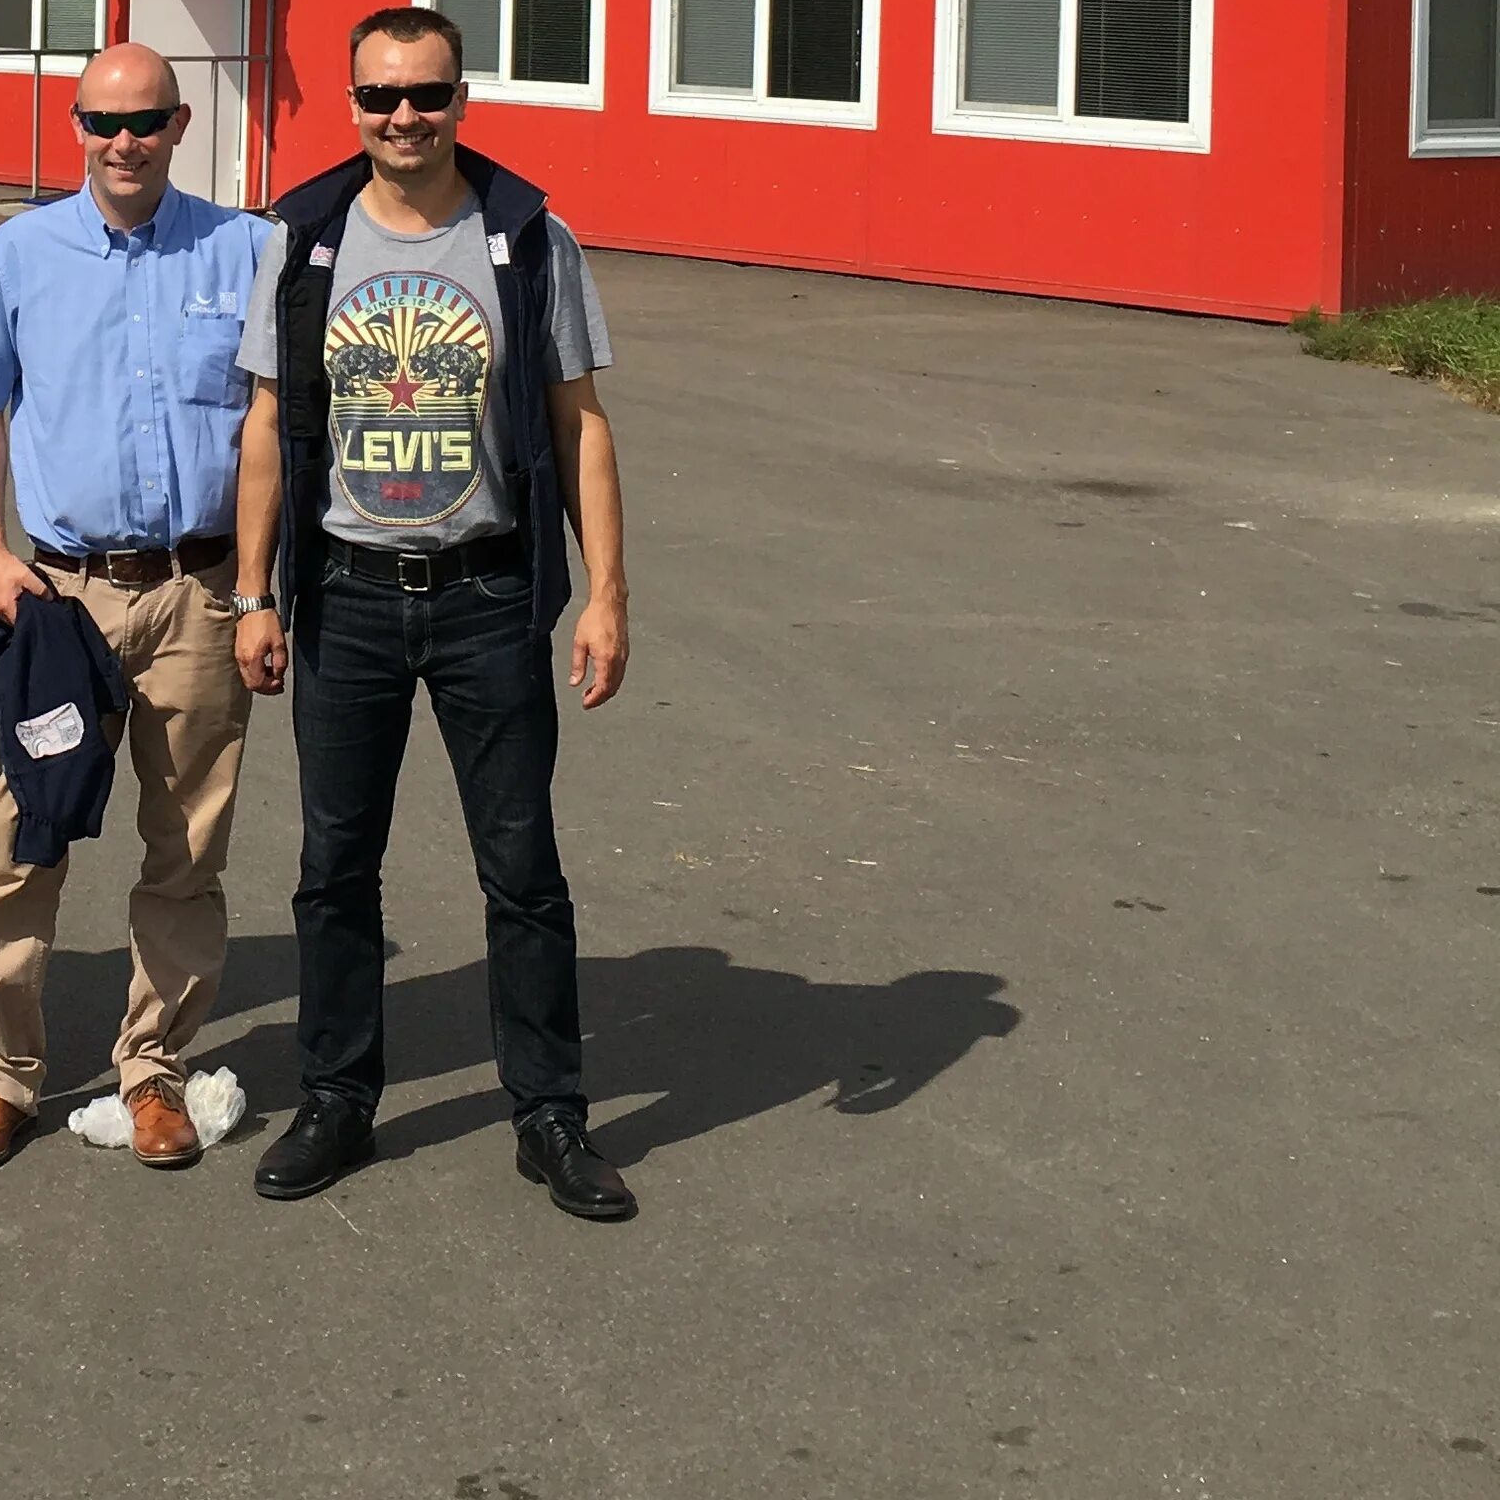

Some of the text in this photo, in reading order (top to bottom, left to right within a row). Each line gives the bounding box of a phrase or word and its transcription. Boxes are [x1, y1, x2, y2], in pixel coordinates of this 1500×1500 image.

[365, 296, 445, 315] SINCE 1873
[342, 429, 472, 472] LEVI'S
